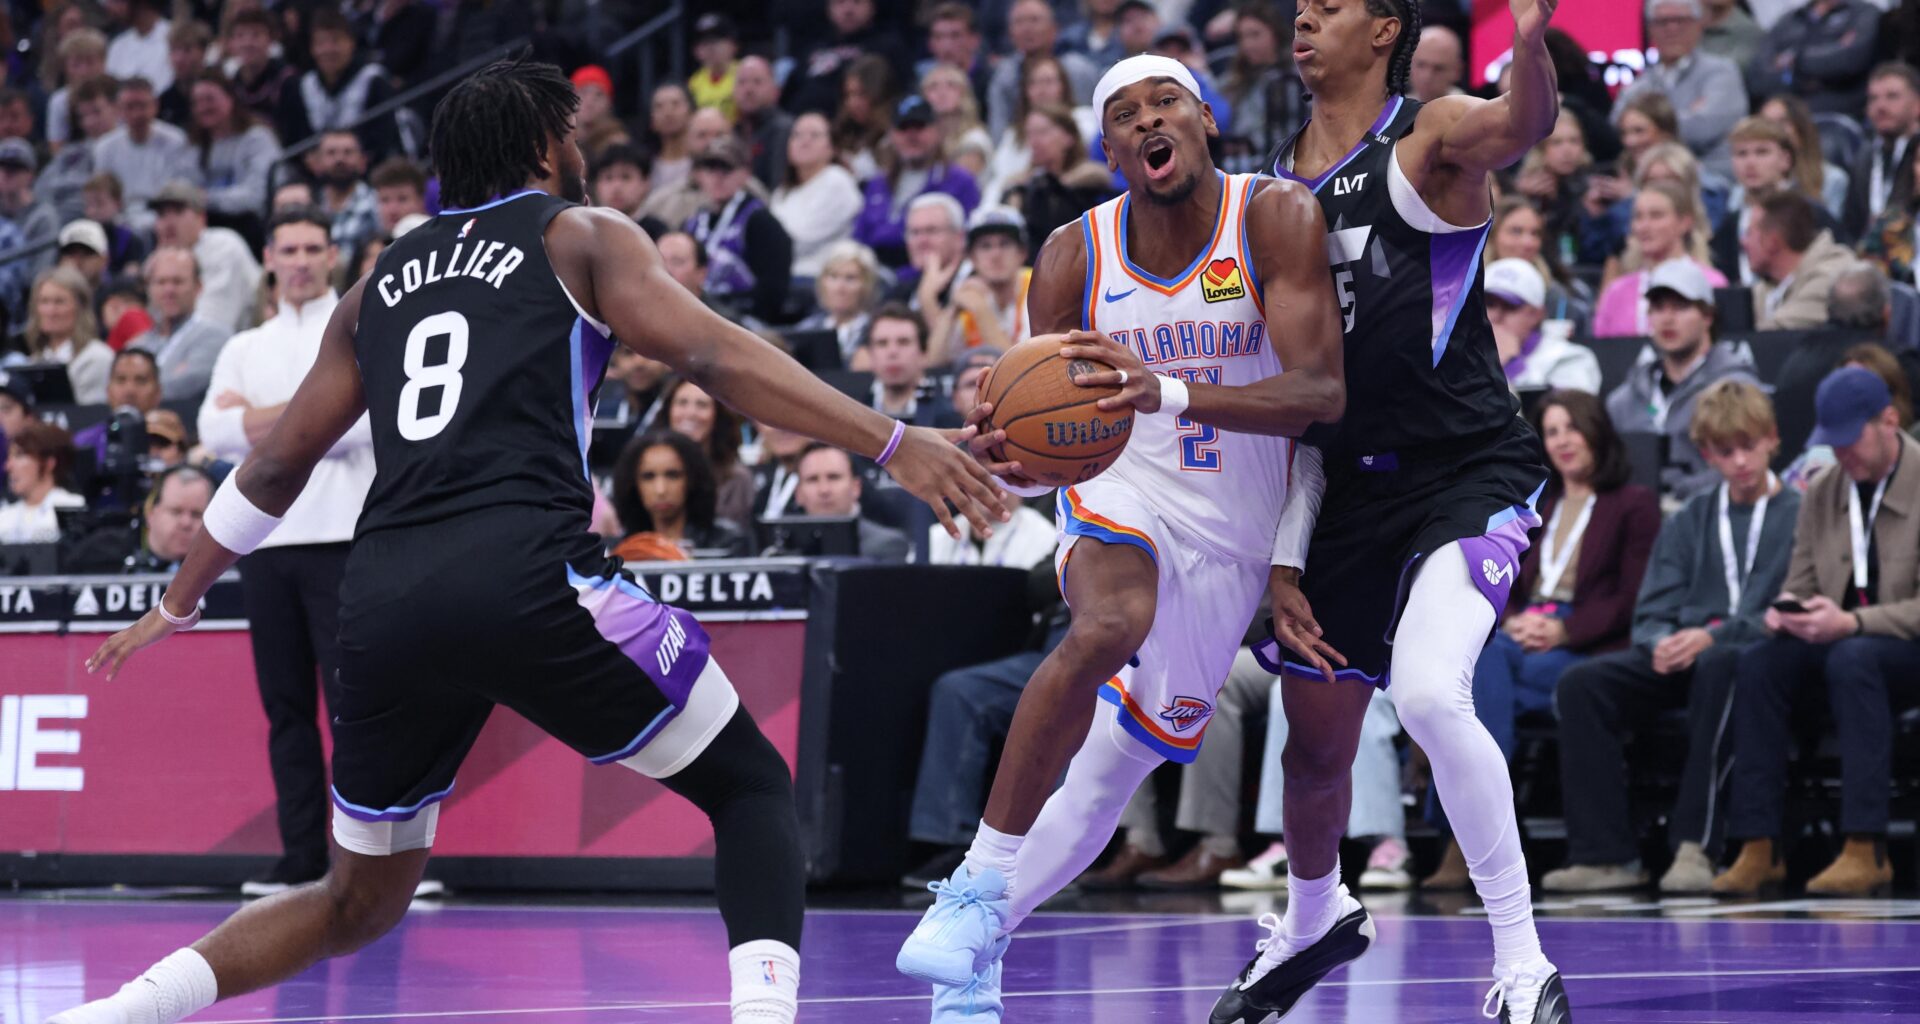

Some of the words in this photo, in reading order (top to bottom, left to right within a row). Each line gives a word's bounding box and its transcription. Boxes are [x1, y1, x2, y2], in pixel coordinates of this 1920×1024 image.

[1333, 172, 1368, 196] LVT
[377, 240, 524, 308] COLLIER
[1336, 270, 1356, 334] 5
[397, 311, 469, 441] 8
[1152, 366, 1222, 386] TY
[1044, 415, 1132, 447] Wilson
[1177, 415, 1222, 473] 2
[0, 585, 34, 613] TA
[660, 573, 774, 601] DELTA
[656, 614, 687, 676] UTAH
